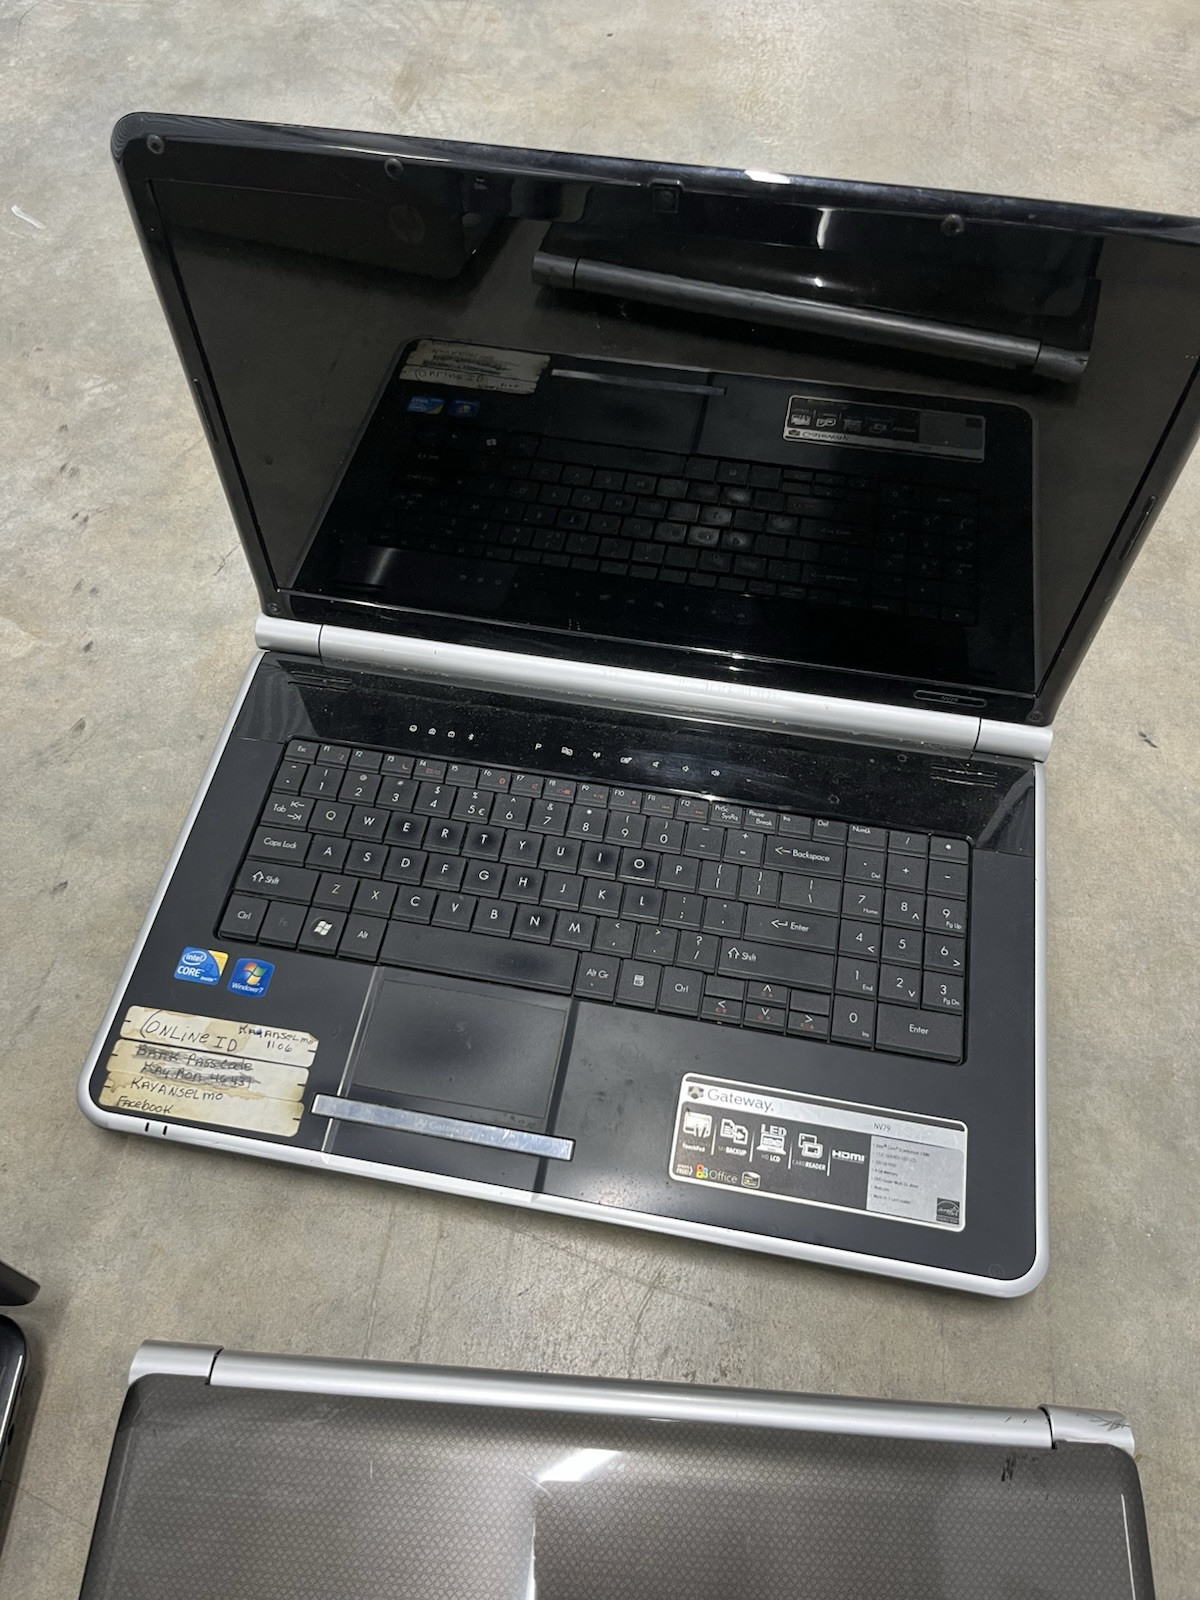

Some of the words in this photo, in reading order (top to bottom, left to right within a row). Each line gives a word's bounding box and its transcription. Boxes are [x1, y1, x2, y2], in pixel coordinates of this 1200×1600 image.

[483, 769, 492, 777] F6
[319, 782, 324, 791] 1
[355, 787, 363, 797] 2
[614, 789, 625, 797] F10
[391, 793, 400, 802] 3
[273, 803, 287, 813] Tab
[429, 800, 437, 808] 4
[680, 799, 691, 807] F12
[467, 805, 475, 814] 5
[325, 810, 337, 821] Q
[505, 811, 513, 820] 6
[543, 816, 551, 825] 7
[363, 816, 375, 826] W
[755, 818, 773, 827] Break
[817, 819, 830, 827] Del
[402, 822, 411, 832] E
[582, 822, 590, 831] 8
[441, 828, 449, 838] R
[621, 828, 629, 837] 9
[263, 837, 282, 848] Caps
[283, 839, 297, 849] Lock
[480, 834, 489, 844] T
[660, 834, 668, 843] 0
[519, 840, 527, 850] Y
[324, 847, 332, 856] A
[363, 852, 371, 861] S
[556, 847, 565, 856] U
[792, 849, 830, 862] Backspace
[401, 858, 411, 868] D
[633, 858, 645, 869] O
[441, 864, 449, 873] F
[675, 865, 683, 874] P
[265, 874, 280, 885] Shift
[478, 870, 490, 881] G
[518, 877, 528, 887] H
[331, 884, 341, 894] Z
[560, 883, 566, 893] J
[371, 890, 380, 900] X
[598, 889, 607, 899] K
[858, 894, 866, 904] 7
[410, 896, 420, 907] C
[639, 896, 645, 906] L
[451, 902, 459, 912] V
[901, 902, 908, 911] 8
[237, 910, 251, 920] Ctrl
[490, 908, 498, 919] B
[863, 908, 879, 916] Home
[942, 908, 951, 919] 9
[529, 916, 541, 926] N
[568, 922, 581, 933] M
[790, 921, 810, 932] Enter
[357, 930, 369, 939] Alt
[855, 933, 863, 942] 4
[696, 935, 703, 945] ?
[898, 939, 906, 949] 5
[940, 946, 949, 956] 6
[741, 951, 757, 962] Shift
[586, 968, 597, 977] Alt
[598, 970, 610, 979] Gr
[855, 970, 860, 980] 1
[862, 983, 873, 992] End
[896, 977, 904, 988] 2
[674, 983, 689, 993] Ctrl
[940, 984, 947, 995] 3
[909, 1024, 929, 1035] Enter
[760, 1123, 787, 1136] LED
[770, 1155, 781, 1163] LCD
[708, 1169, 738, 1183] Office
